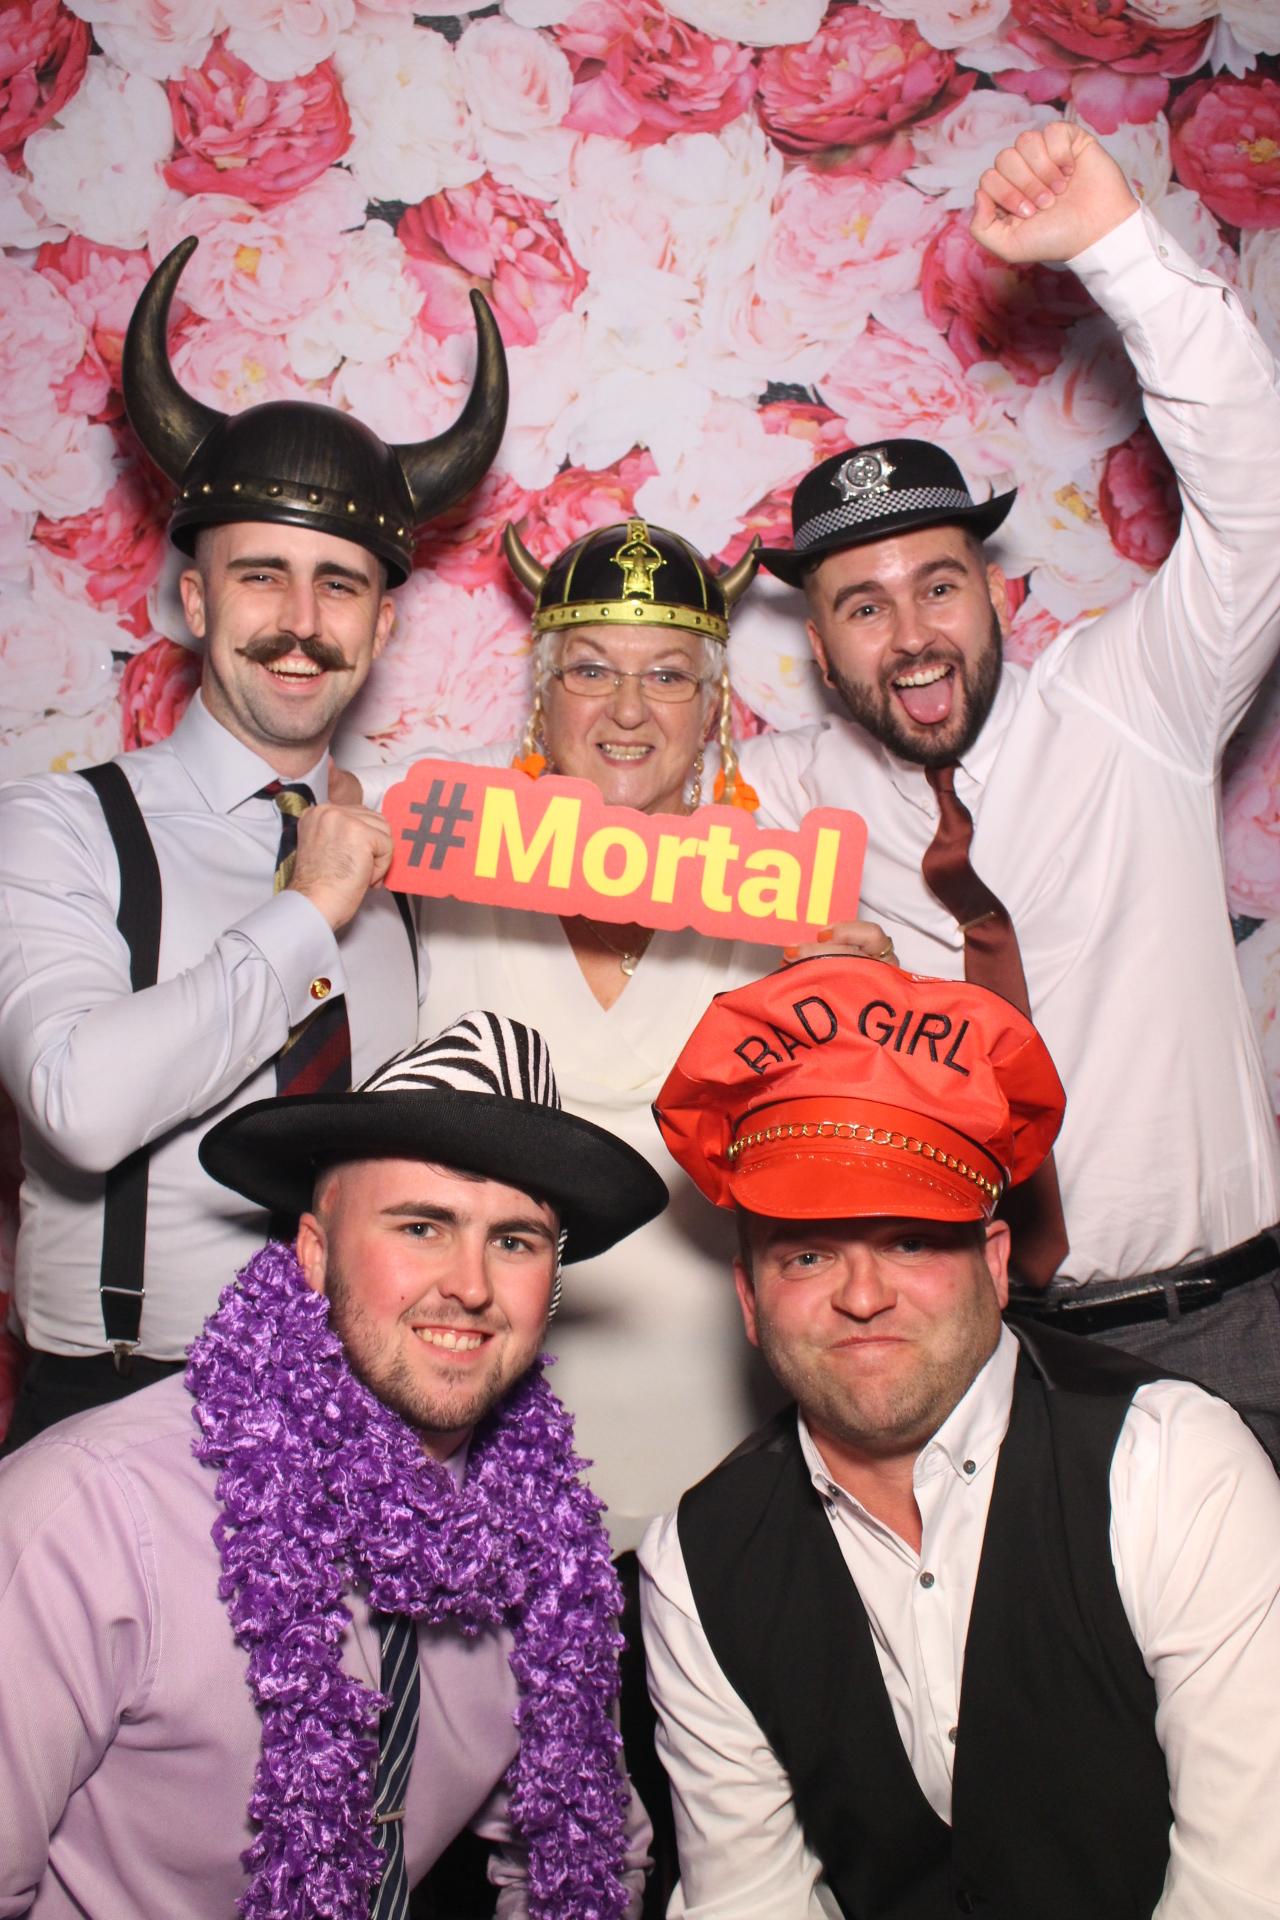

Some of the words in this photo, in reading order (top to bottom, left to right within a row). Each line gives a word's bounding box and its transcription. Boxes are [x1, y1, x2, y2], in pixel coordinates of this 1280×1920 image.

[401, 779, 841, 926] #Mortal
[734, 995, 838, 1074] BAD
[857, 1000, 970, 1076] GIRL
